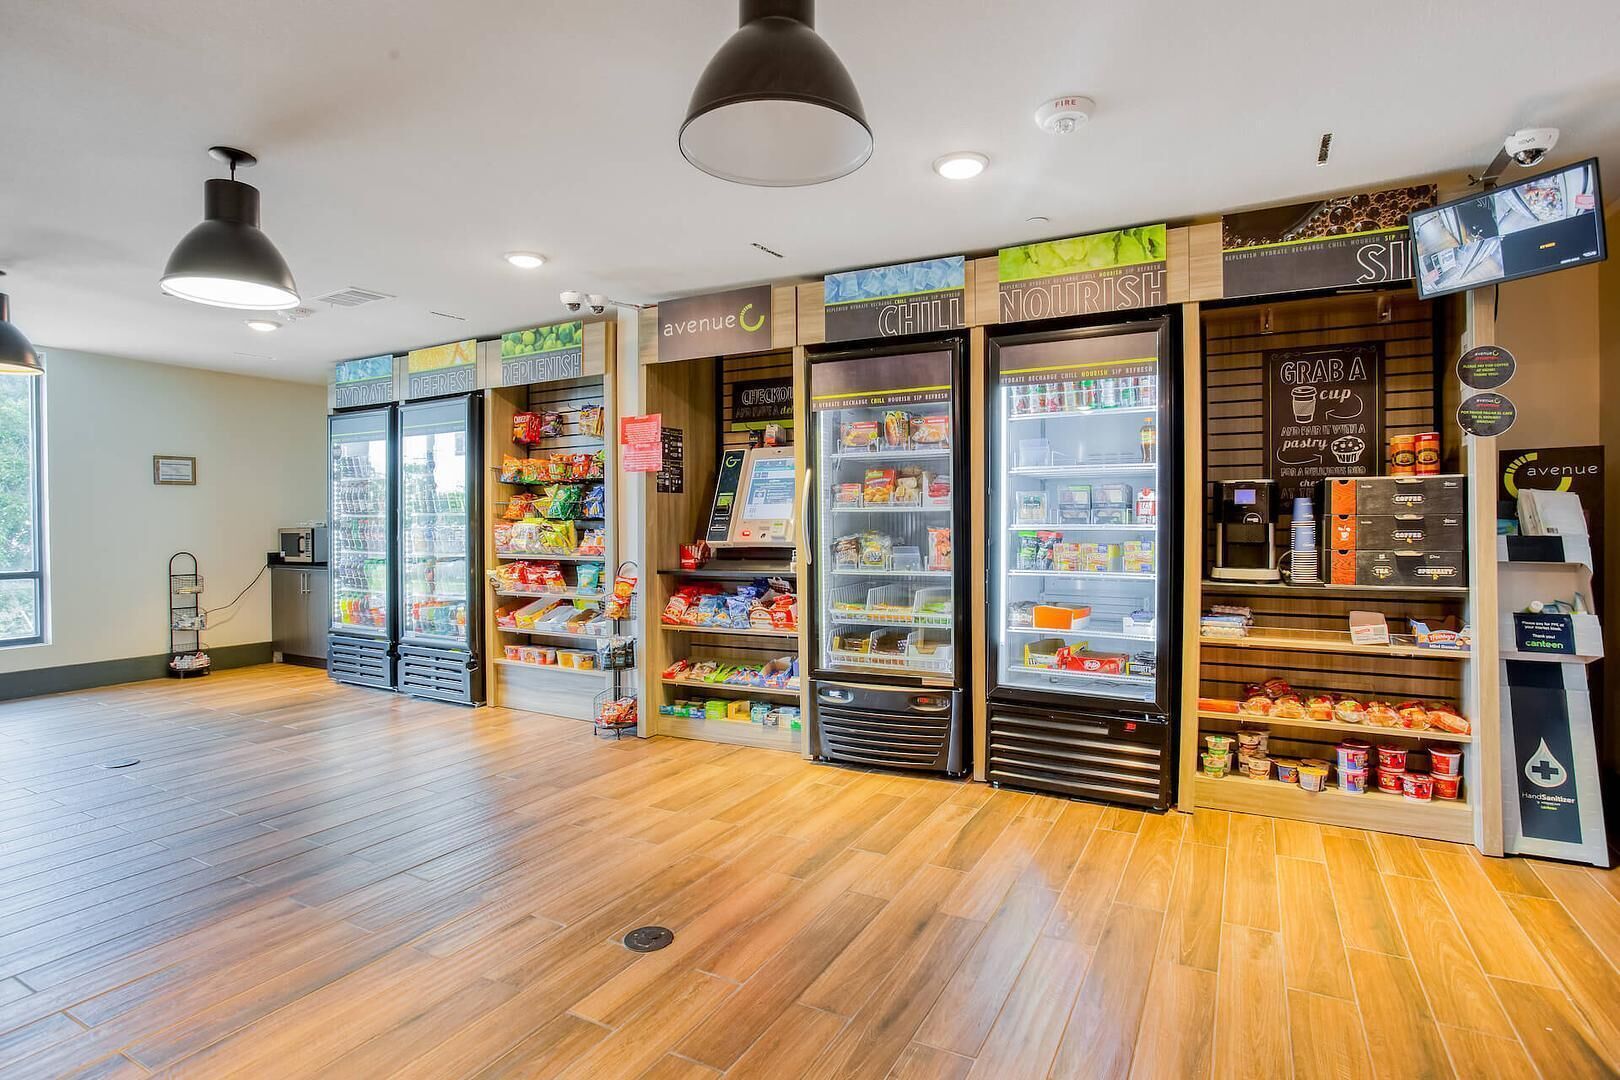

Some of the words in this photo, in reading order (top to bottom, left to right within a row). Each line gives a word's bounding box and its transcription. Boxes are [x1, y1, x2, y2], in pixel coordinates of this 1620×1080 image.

[1055, 99, 1077, 108] FIRE
[1225, 252, 1257, 261] REPLENISH
[1292, 244, 1324, 252] RECHARGE
[1356, 240, 1412, 284] SI
[1000, 270, 1166, 323] NOURISH
[663, 314, 736, 336] avenue
[878, 298, 966, 337] CHILL
[502, 352, 582, 386] REPLENISH
[1280, 358, 1344, 385] GRAB
[1348, 357, 1367, 380] A
[411, 368, 475, 398] REFRESH
[336, 382, 392, 408] HYDRATE
[1320, 388, 1351, 403] cup
[1281, 426, 1300, 437] AND
[1301, 425, 1321, 436] PAIR
[1322, 424, 1331, 435] IT
[1332, 424, 1357, 435] WITH
[1358, 424, 1366, 434] A
[1282, 438, 1328, 452] pastry
[1281, 467, 1296, 477] FOR
[1297, 467, 1304, 476] A
[1527, 465, 1598, 476] avenue
[1525, 640, 1564, 649] canteen
[1522, 792, 1576, 803] HandSanitizer
